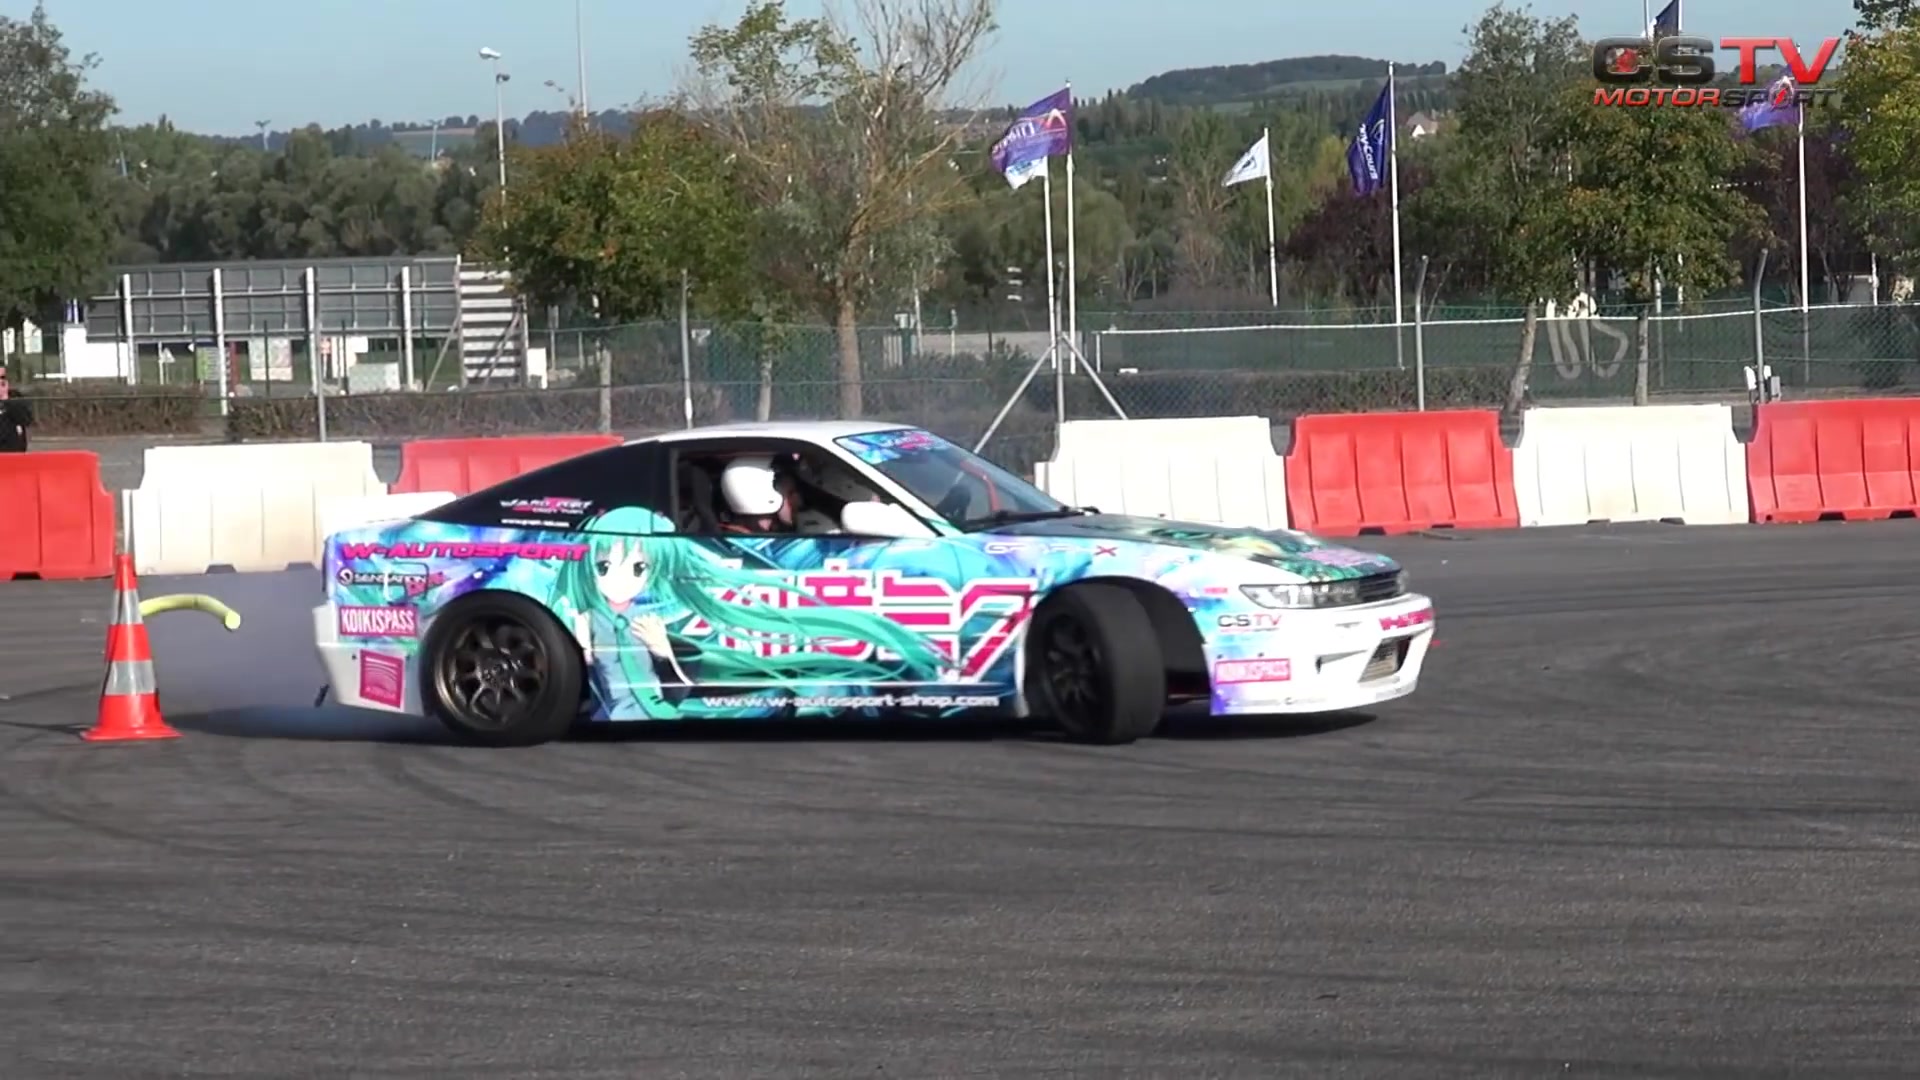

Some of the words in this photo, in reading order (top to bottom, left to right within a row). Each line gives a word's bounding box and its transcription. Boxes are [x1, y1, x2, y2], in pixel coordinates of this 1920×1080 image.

[342, 542, 591, 560] W-AUTOSPORT
[341, 608, 415, 633] KOIKISPASS
[1217, 614, 1282, 627] CSTV
[702, 695, 1000, 709] www.w-autosport-shop.com
